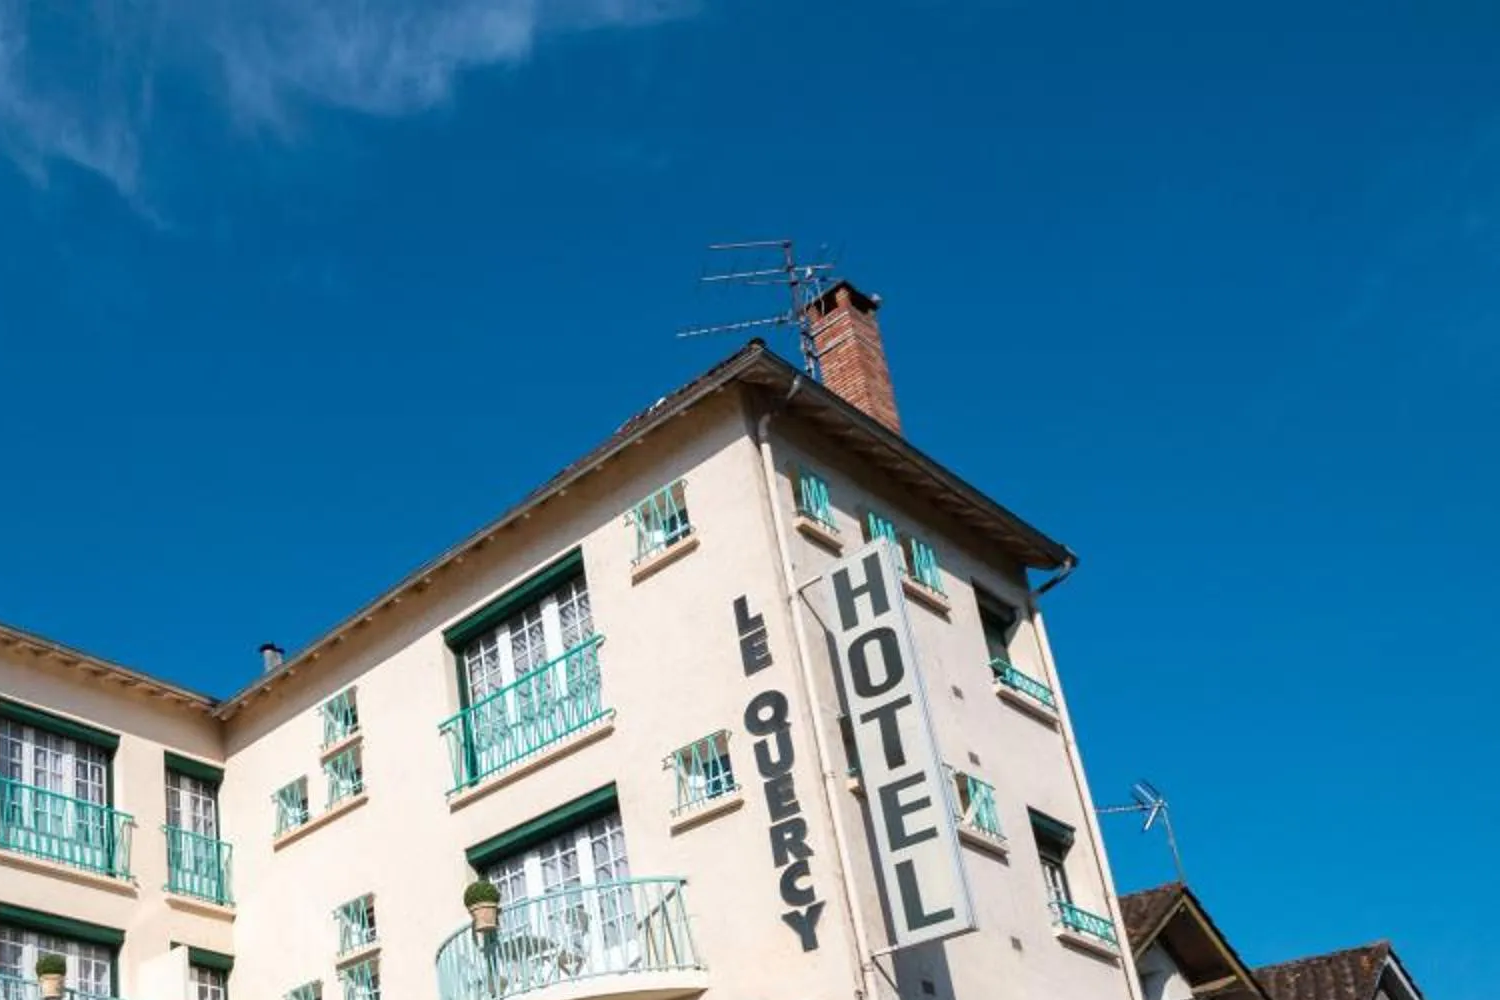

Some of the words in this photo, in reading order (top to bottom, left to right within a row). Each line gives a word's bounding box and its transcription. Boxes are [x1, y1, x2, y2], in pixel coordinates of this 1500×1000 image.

[733, 595, 773, 676] LE
[832, 551, 956, 931] HOTEL
[744, 689, 825, 952] QUERCY
